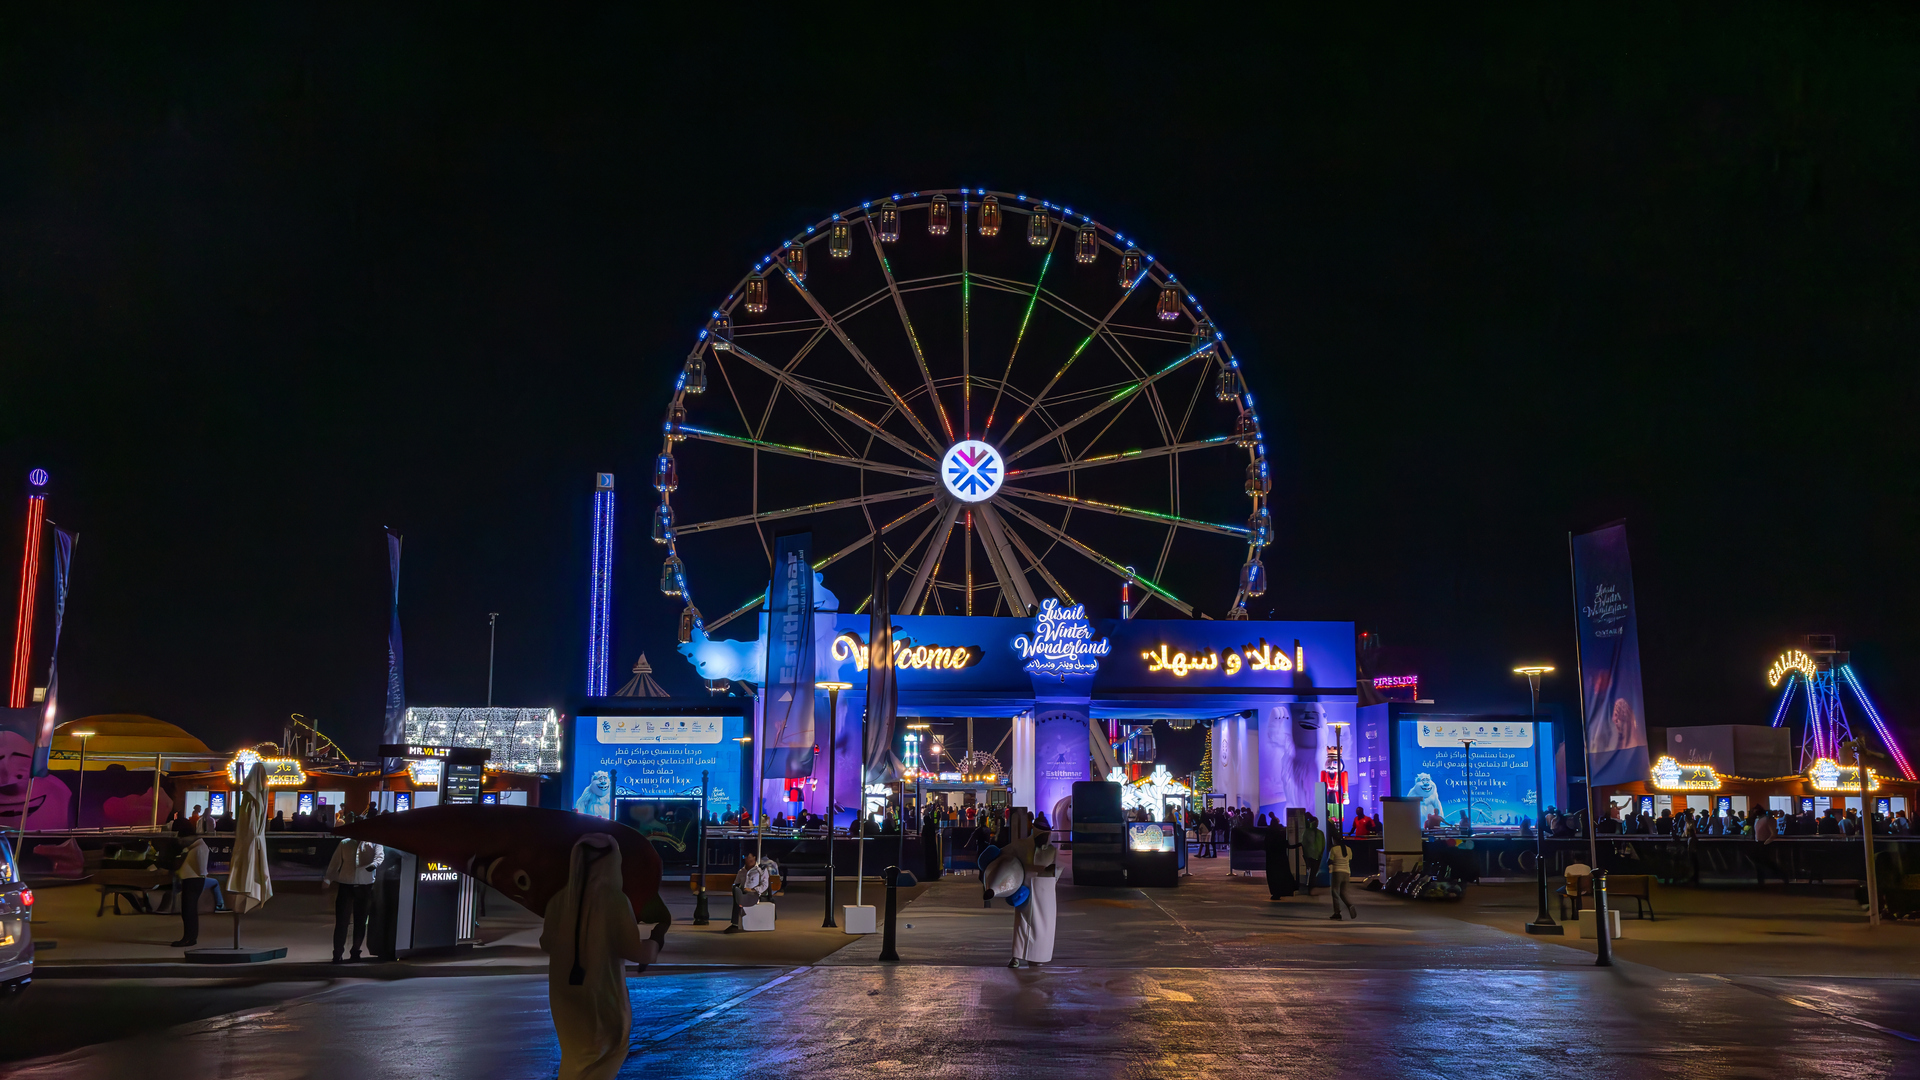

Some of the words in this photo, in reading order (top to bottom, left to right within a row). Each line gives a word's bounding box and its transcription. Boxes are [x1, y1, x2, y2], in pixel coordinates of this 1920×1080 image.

[779, 552, 799, 684] Estithmar
[1038, 598, 1085, 628] Lusail
[1036, 622, 1093, 642] Winter
[1014, 636, 1110, 661] Wonderland
[1226, 653, 1242, 676] و
[1769, 649, 1816, 687] GALLEON
[1373, 675, 1418, 687] FIRESLIDE
[409, 747, 451, 757] MR.VALET
[1684, 780, 1714, 788] TICKETS
[420, 872, 458, 881] PARKING
[427, 862, 452, 871] VALE
